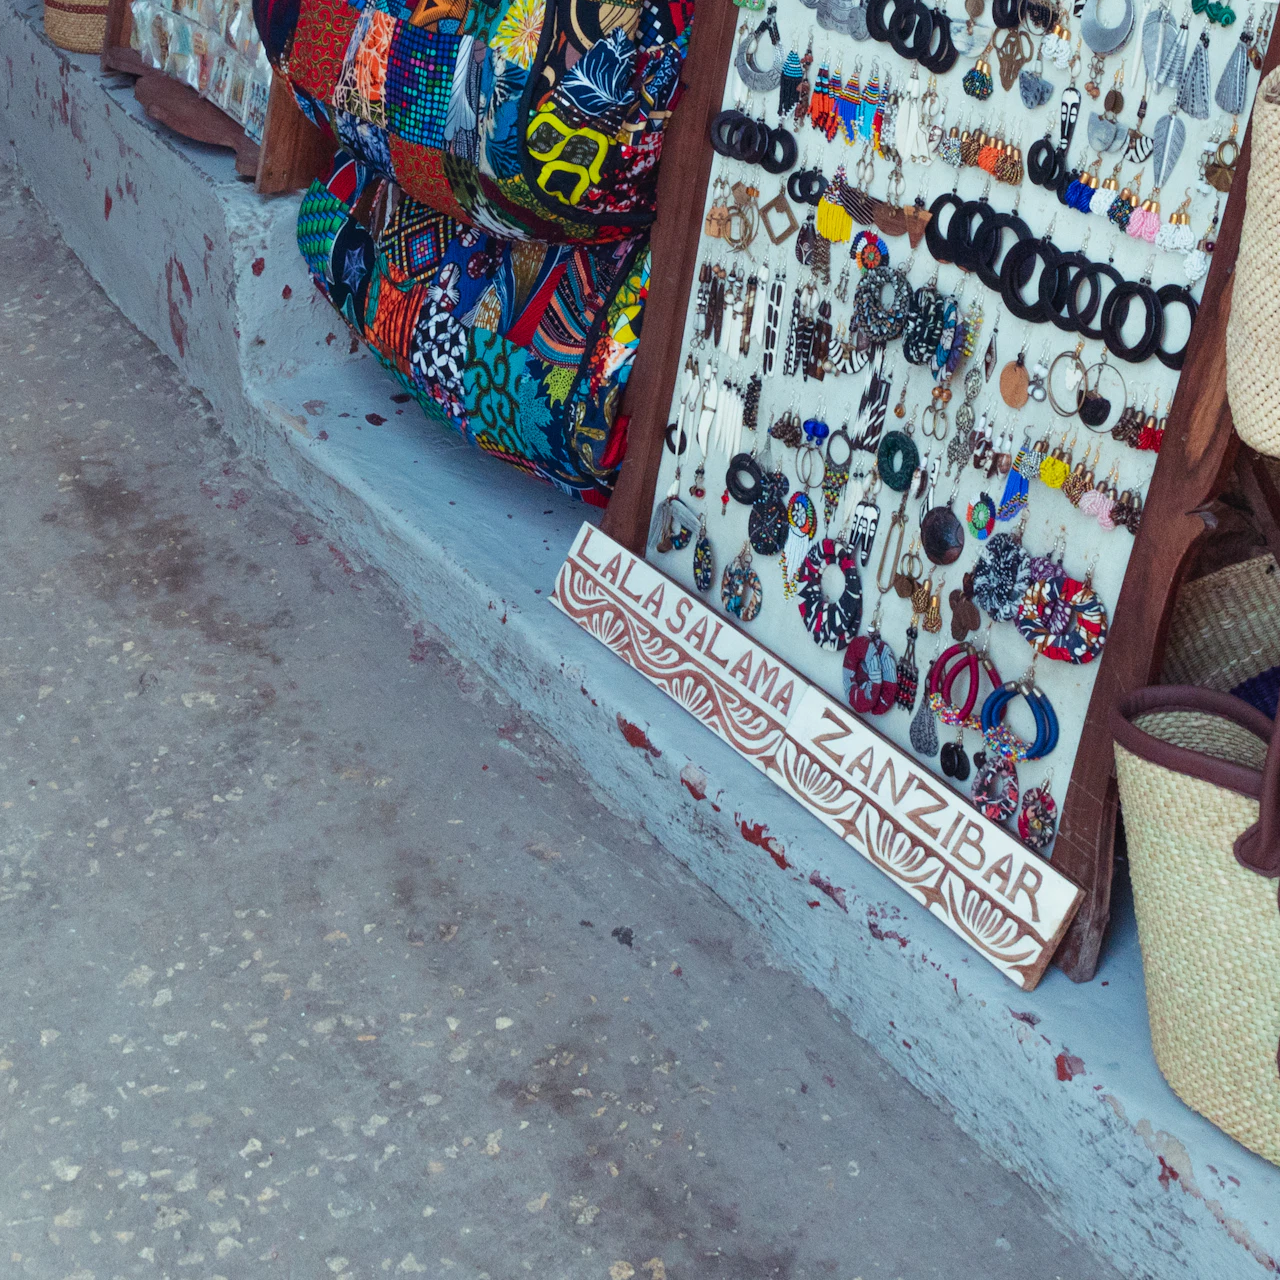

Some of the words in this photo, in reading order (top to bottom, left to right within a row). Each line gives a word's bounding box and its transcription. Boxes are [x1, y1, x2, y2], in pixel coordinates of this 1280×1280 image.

[574, 525, 666, 619] LALA
[665, 600, 797, 717] SALAMA
[811, 706, 1043, 923] ZANZIBAR
